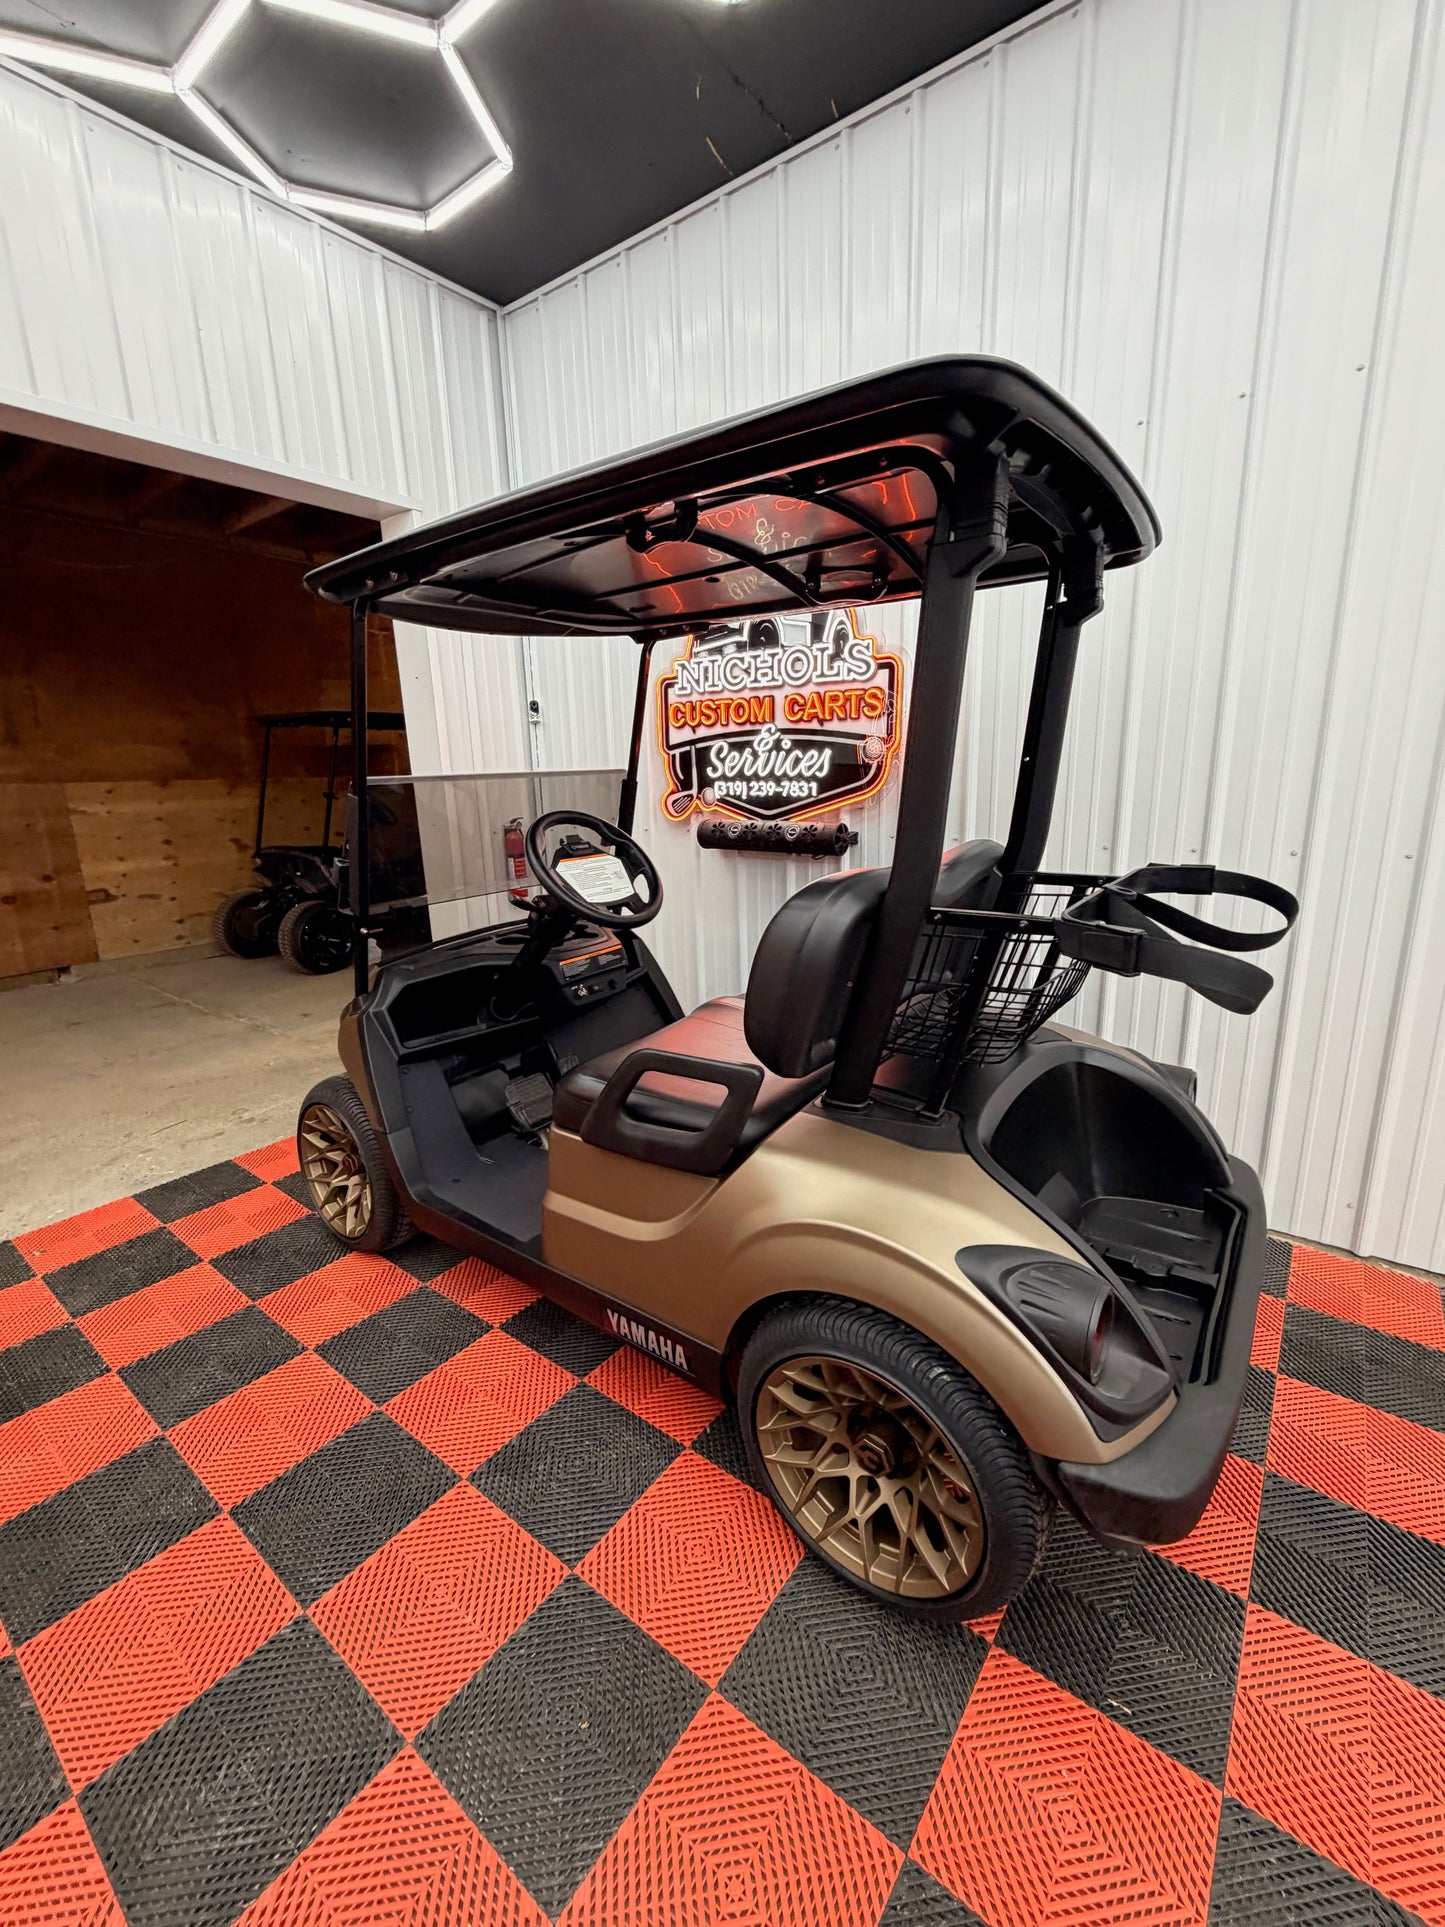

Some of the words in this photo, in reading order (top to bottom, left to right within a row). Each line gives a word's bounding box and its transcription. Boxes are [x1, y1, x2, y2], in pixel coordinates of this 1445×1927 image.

[674, 640, 876, 695] NICHOLS
[669, 695, 775, 728] CUSTOM
[784, 686, 886, 723] CARTS
[706, 739, 833, 778] Services
[753, 723, 782, 756] &
[749, 781, 818, 797] 239-7831
[607, 1308, 689, 1371] YAMAHA
